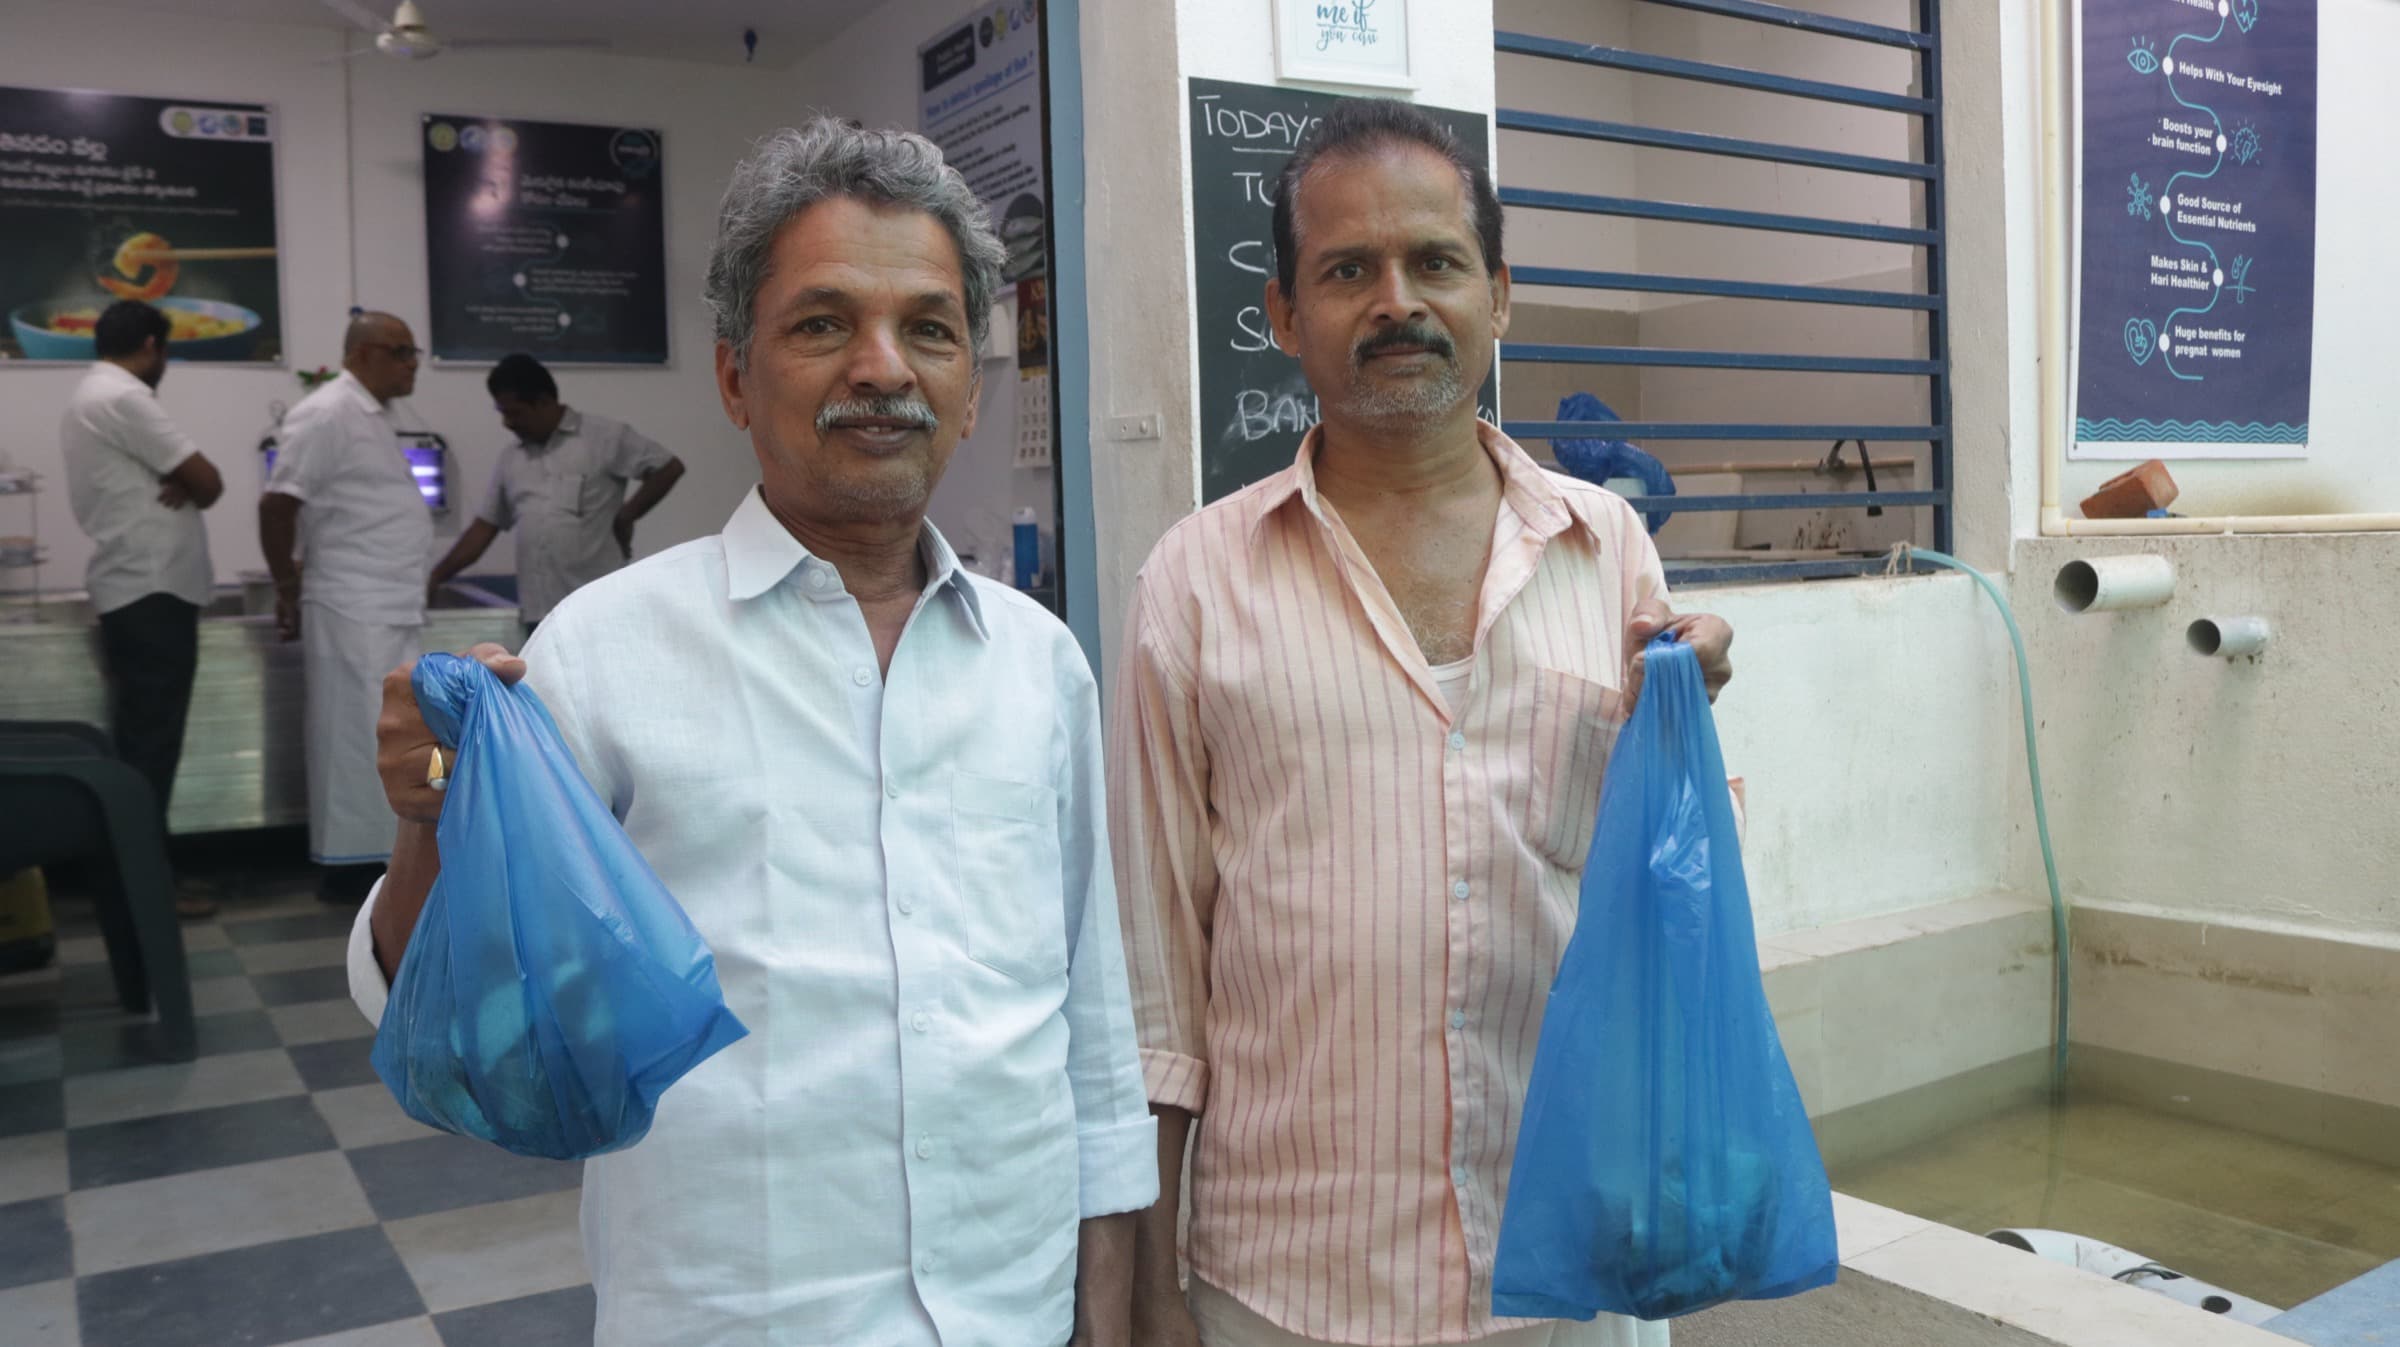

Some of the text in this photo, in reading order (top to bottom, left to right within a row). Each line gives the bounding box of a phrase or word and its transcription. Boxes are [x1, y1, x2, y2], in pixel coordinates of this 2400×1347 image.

[1316, 0, 1376, 32] me if
[1316, 28, 1346, 51] you
[2179, 61, 2282, 96] Helps With Your Eyesight
[2163, 118, 2213, 139] Boosts your
[2152, 133, 2212, 156] brain function
[2177, 193, 2243, 214] Good Source of
[2177, 210, 2257, 233] Essential Nutrients
[2151, 254, 2208, 274] Makes Skin &
[2151, 272, 2210, 291] Hari Healthier
[2174, 324, 2246, 342] Huge benefits for
[2211, 347, 2241, 359] women
[1235, 388, 1320, 441] BAN
